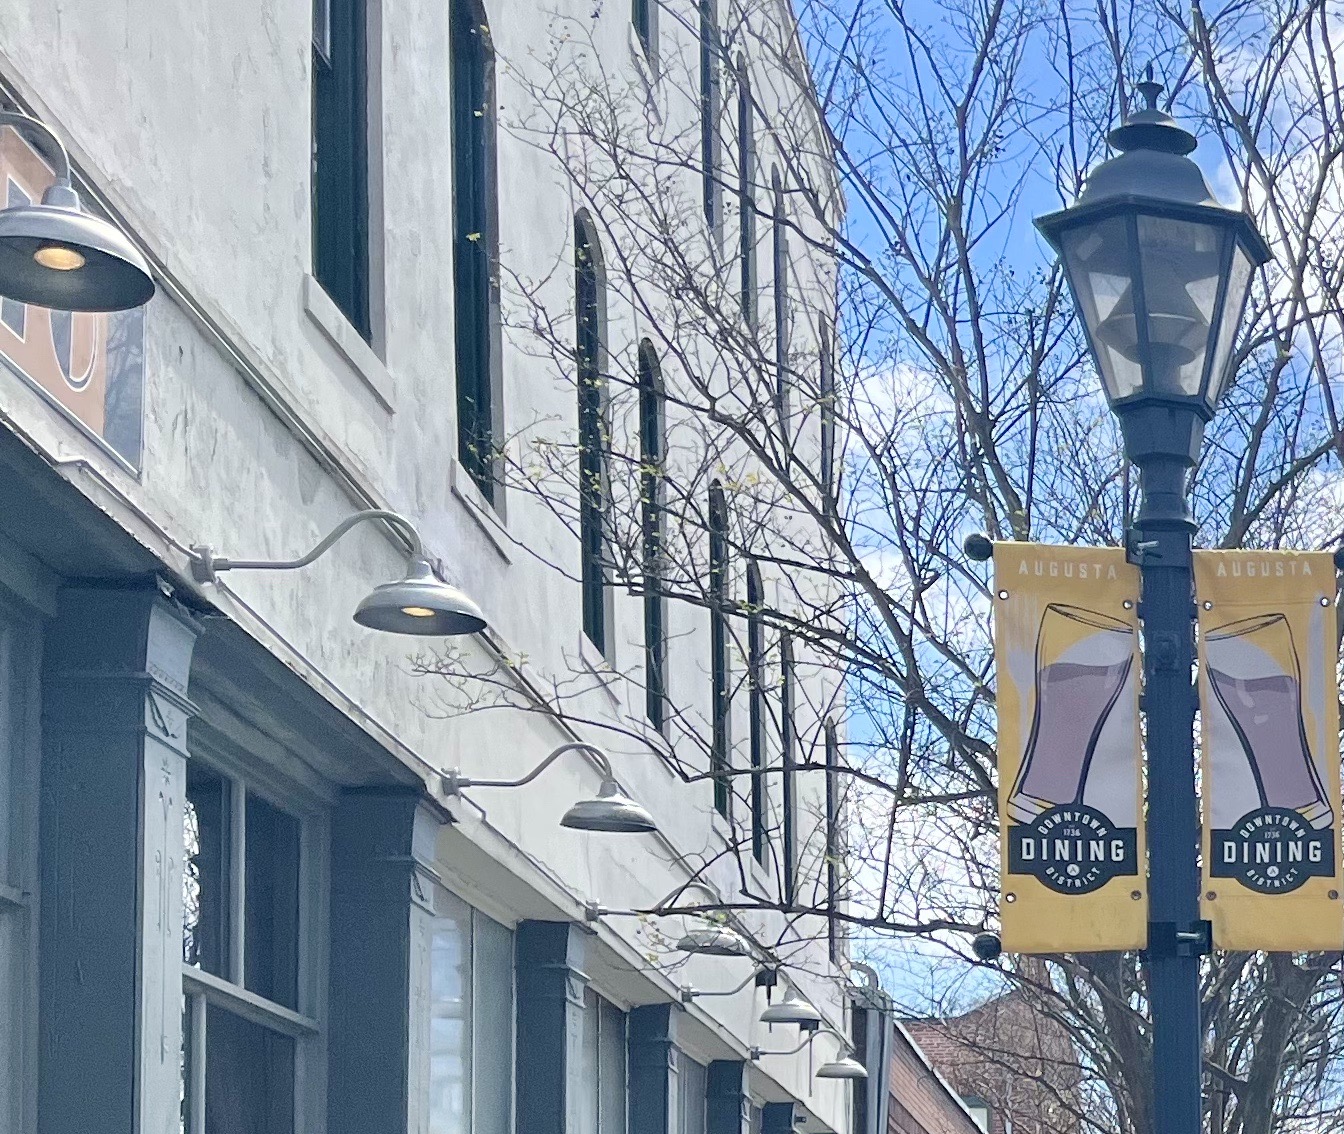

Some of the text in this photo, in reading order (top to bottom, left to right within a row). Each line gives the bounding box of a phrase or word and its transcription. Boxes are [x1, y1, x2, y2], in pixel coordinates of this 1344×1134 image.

[1018, 560, 1118, 580] AUGUSTA
[1217, 561, 1312, 577] AUGUSTA
[1037, 811, 1108, 837] DOWNTOWN
[1063, 828, 1081, 837] 1736
[1240, 814, 1306, 839] DOWNTOWN
[1021, 837, 1125, 862] DINING
[1223, 841, 1322, 863] DINING
[1045, 866, 1101, 888] DISTRICT
[1246, 867, 1299, 888] DISTRICT
